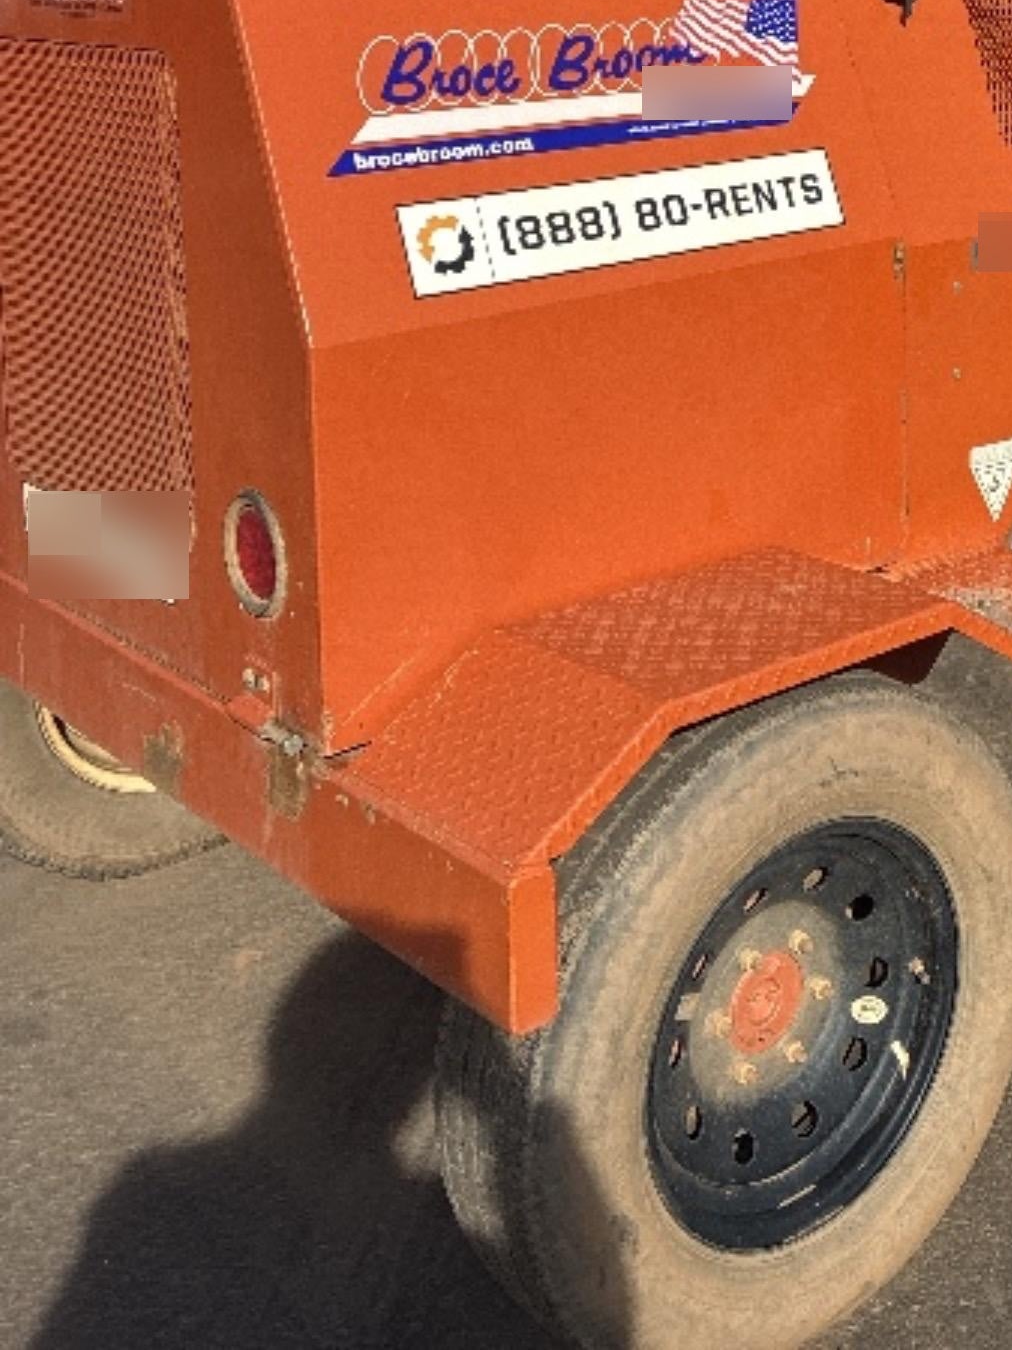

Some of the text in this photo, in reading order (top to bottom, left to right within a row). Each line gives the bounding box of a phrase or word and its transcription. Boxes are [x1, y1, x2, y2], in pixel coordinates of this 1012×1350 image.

[381, 33, 709, 106] Broce Broom
[352, 136, 536, 171] brocebroom.com
[497, 173, 824, 256] (888) 80-RENTS
